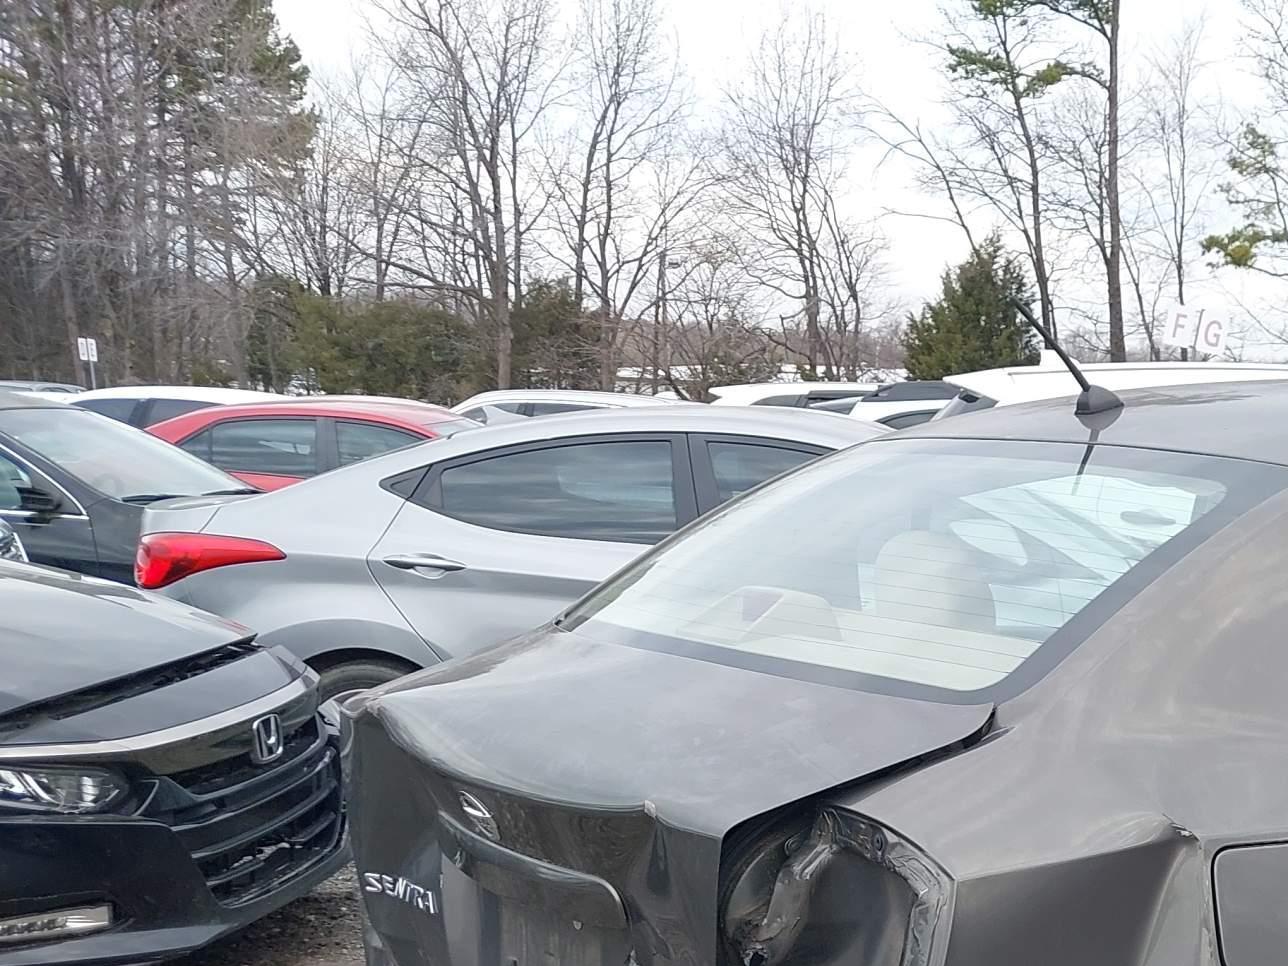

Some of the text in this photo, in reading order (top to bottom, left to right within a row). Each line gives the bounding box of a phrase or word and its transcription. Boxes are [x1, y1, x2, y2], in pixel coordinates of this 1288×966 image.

[1172, 313, 1188, 338] F
[1204, 320, 1223, 347] G
[363, 871, 440, 915] SENTRA
